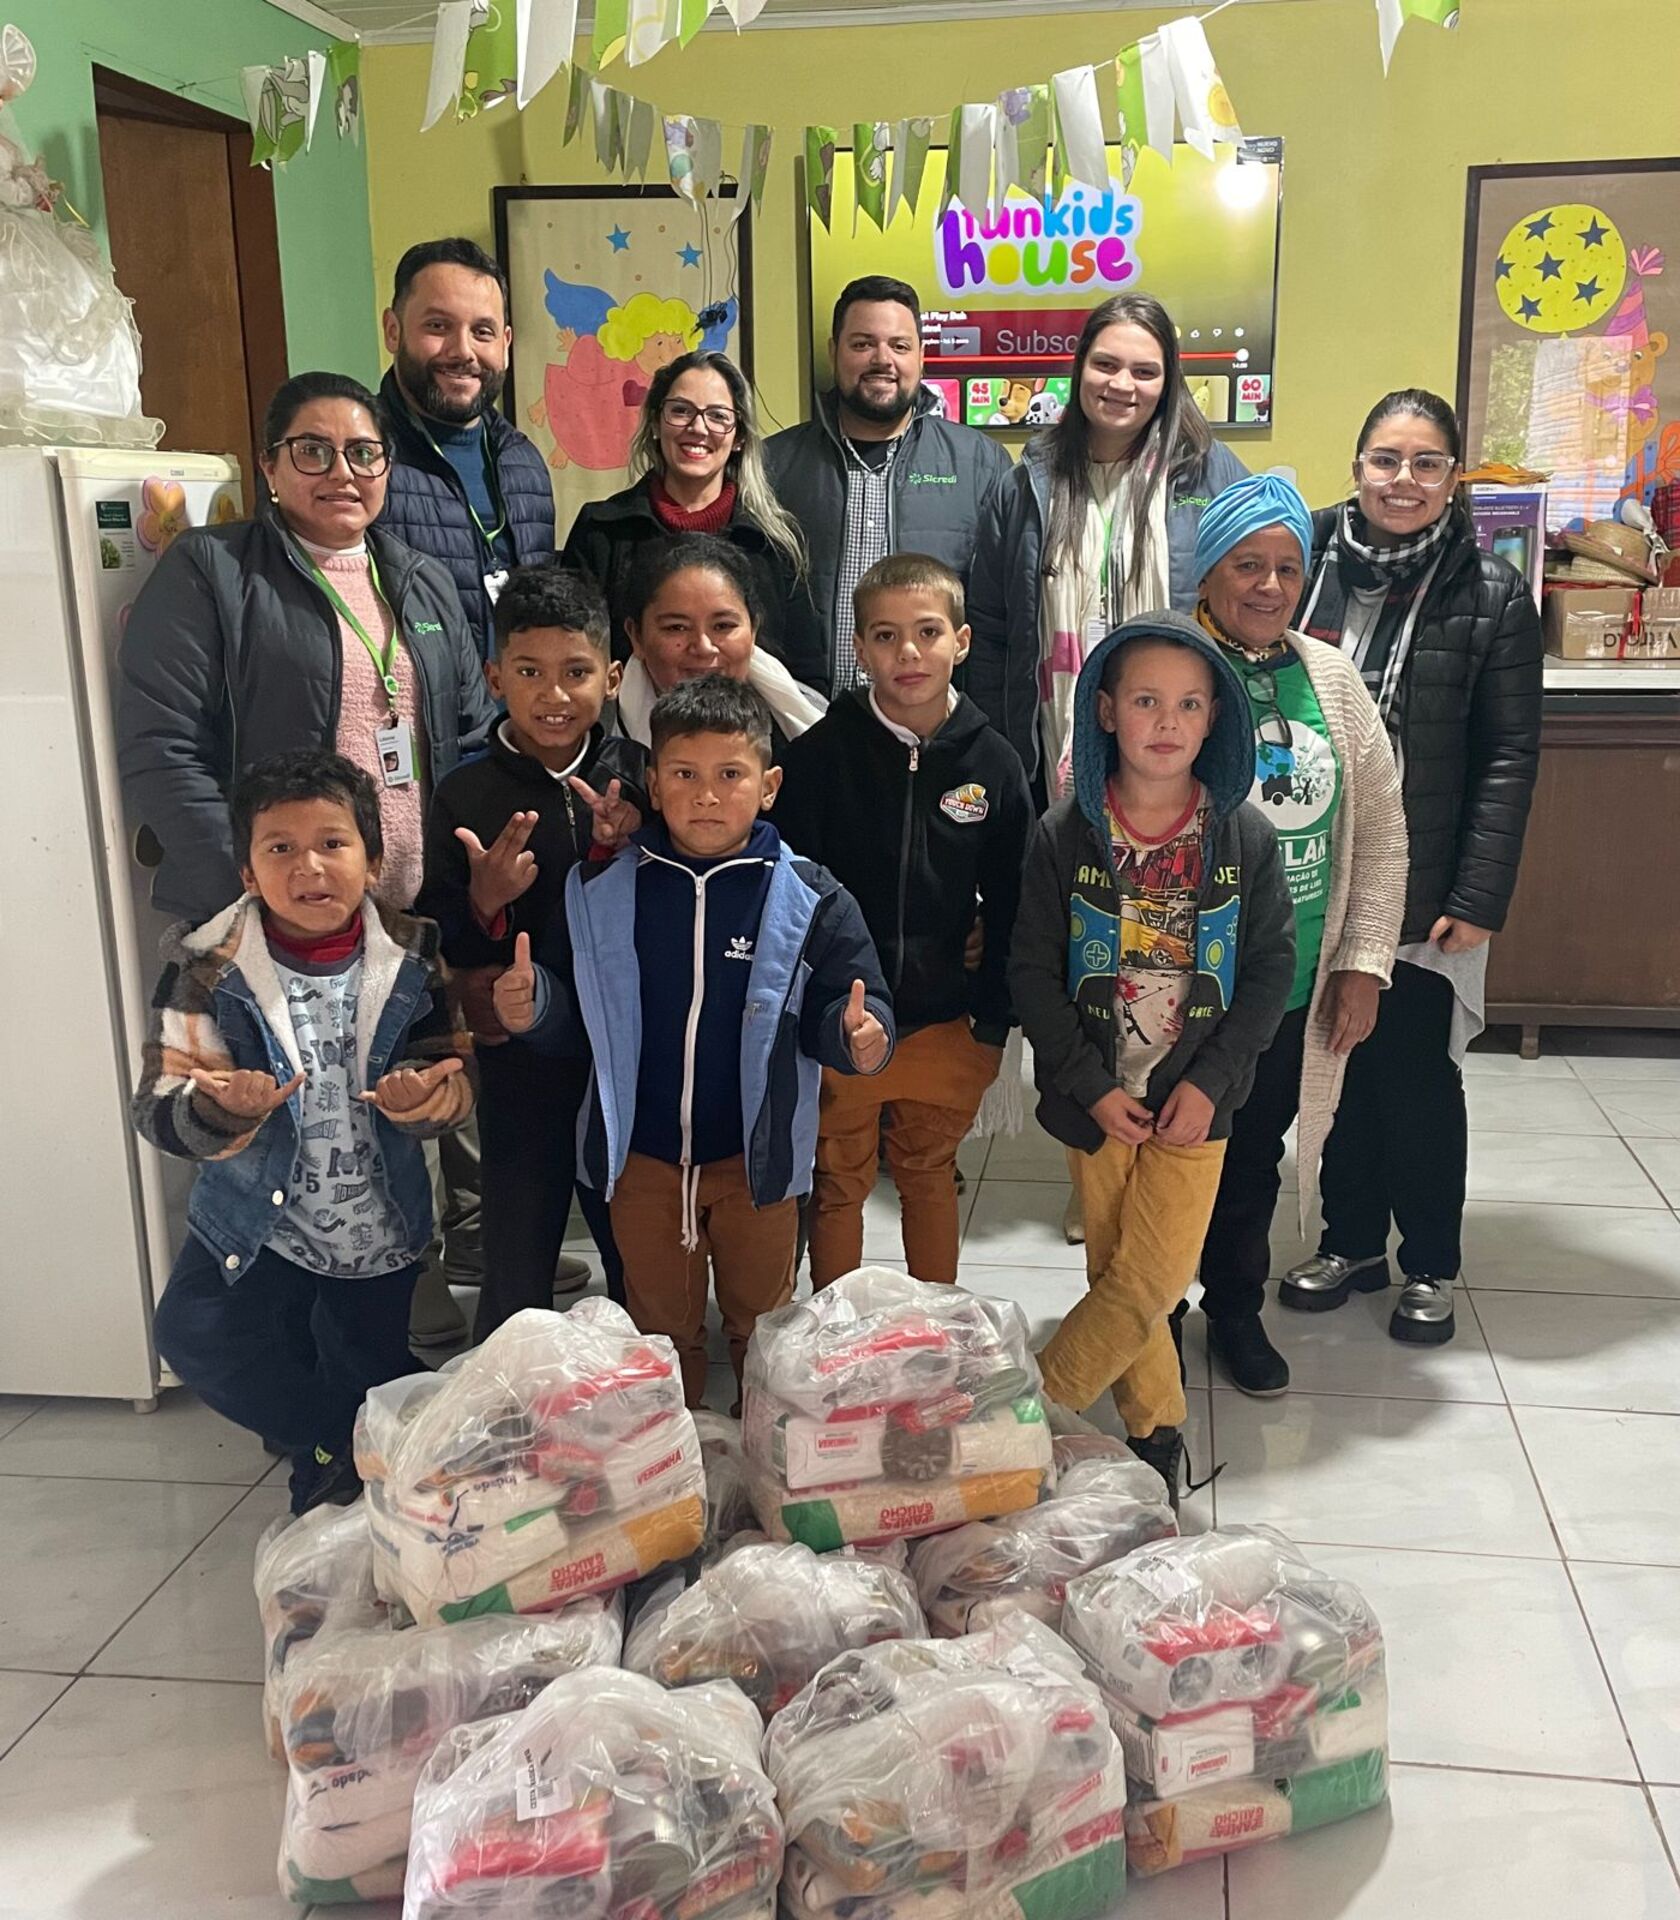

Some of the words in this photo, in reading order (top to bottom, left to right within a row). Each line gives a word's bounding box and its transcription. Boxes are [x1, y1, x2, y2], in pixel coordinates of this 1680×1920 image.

[943, 209, 1134, 289] house
[971, 383, 989, 395] 45
[1242, 379, 1262, 391] 60
[971, 396, 990, 404] MIN
[1242, 392, 1262, 401] MIN
[1279, 833, 1326, 867] LAN
[551, 1552, 604, 1581] GAUCHO
